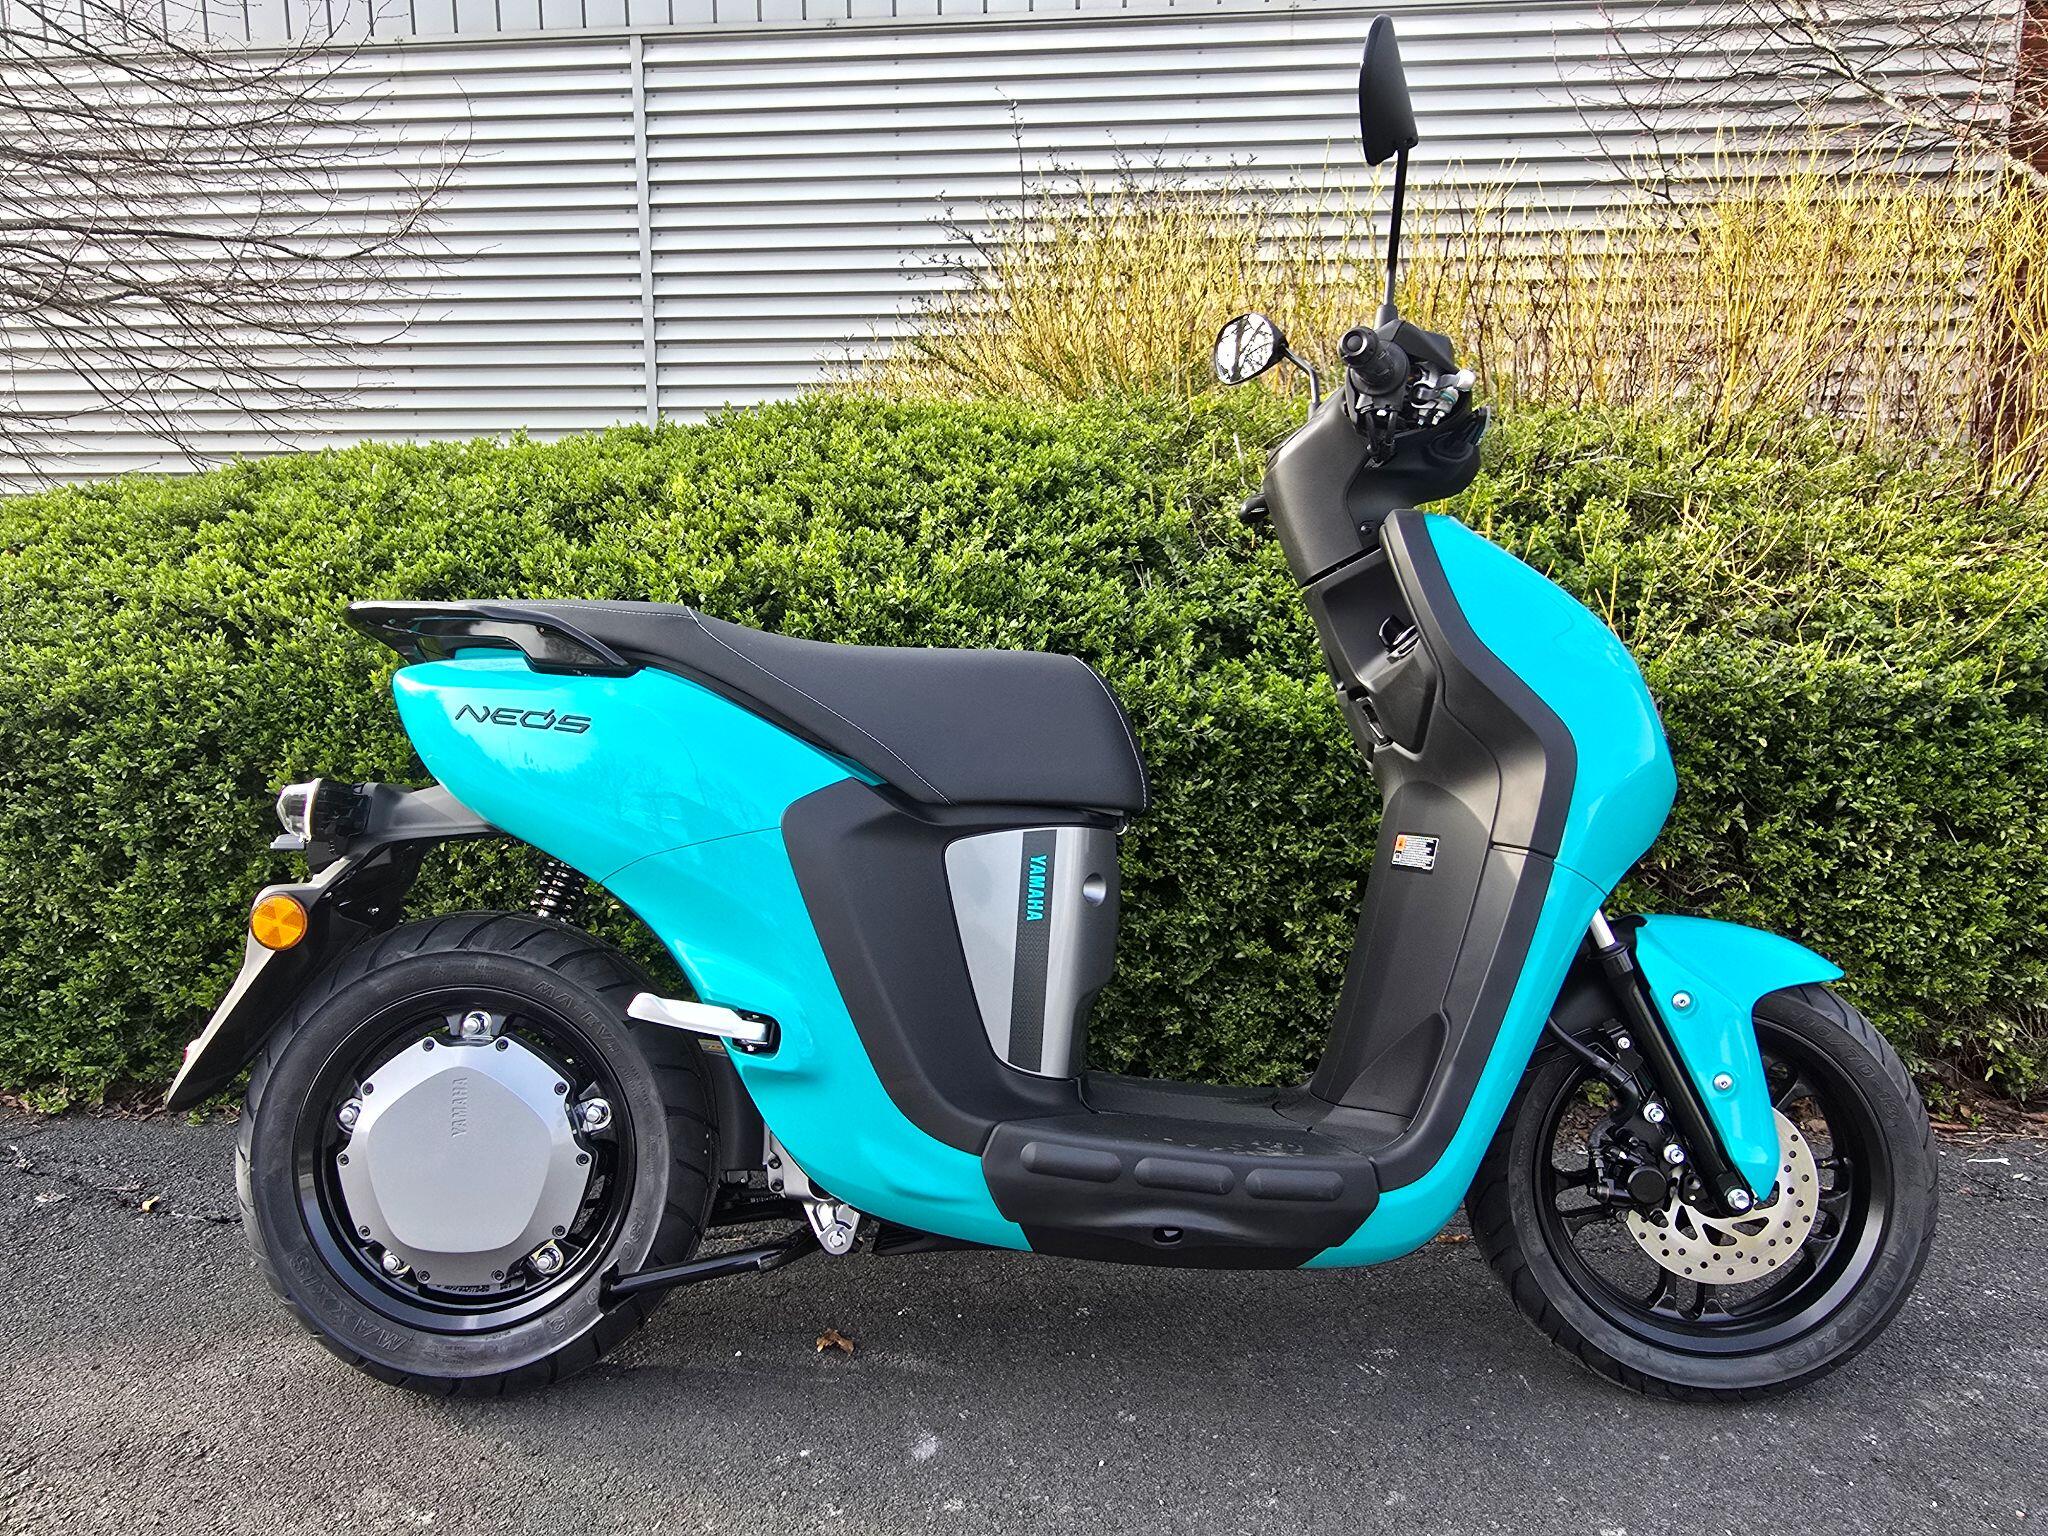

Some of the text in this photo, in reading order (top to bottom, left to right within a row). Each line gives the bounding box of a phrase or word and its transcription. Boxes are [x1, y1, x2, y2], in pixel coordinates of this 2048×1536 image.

[1027, 854, 1047, 921] YAMAHA
[452, 1077, 468, 1136] YAMAHA
[290, 1254, 408, 1352] MAXXIS
